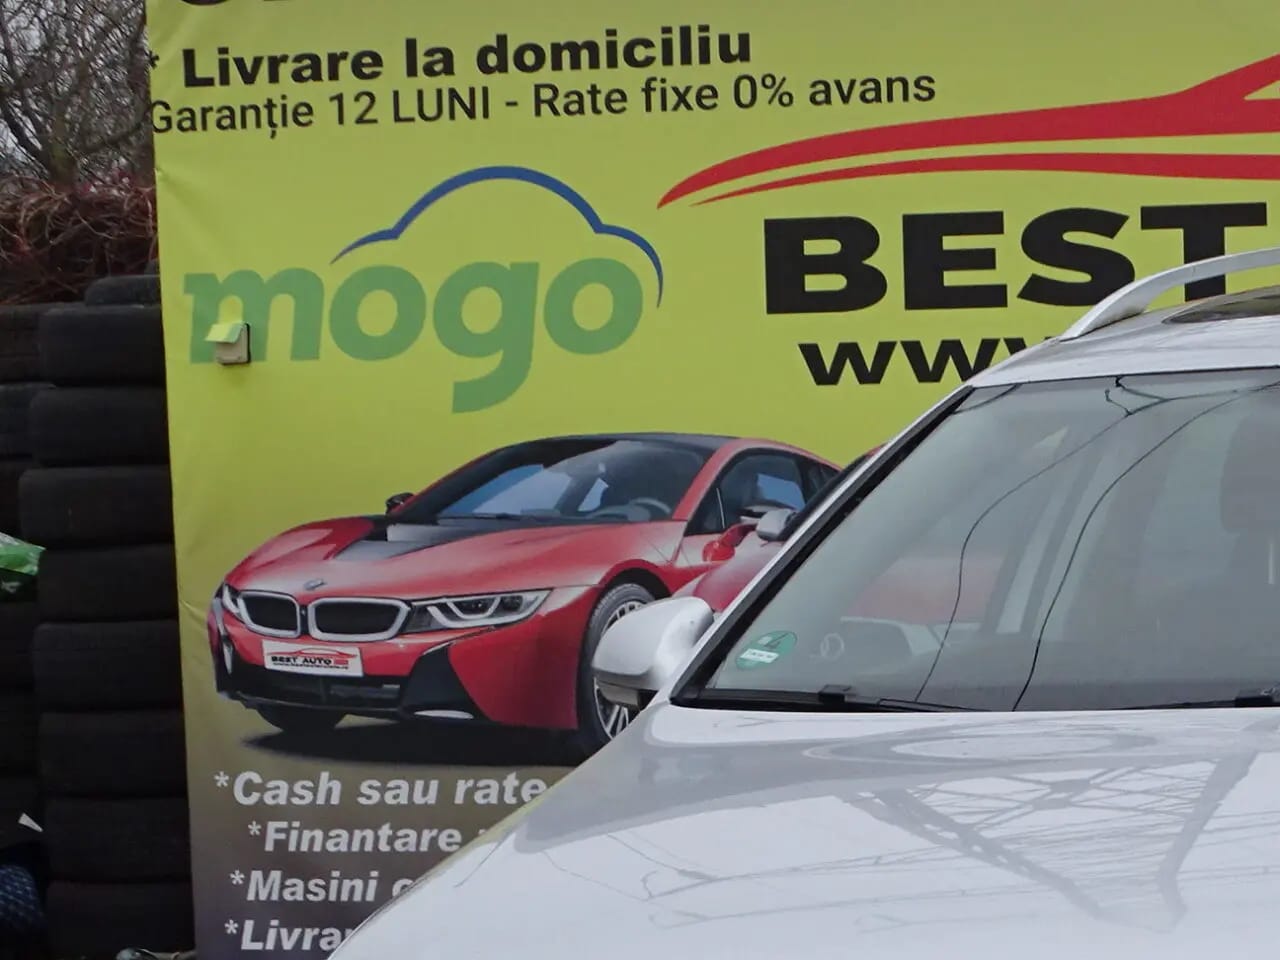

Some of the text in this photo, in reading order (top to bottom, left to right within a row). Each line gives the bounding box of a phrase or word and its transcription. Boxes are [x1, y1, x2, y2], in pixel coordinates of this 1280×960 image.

[182, 25, 751, 88] Livrare la domiciliu
[150, 95, 314, 139] Garanție
[329, 91, 379, 125] 12
[392, 86, 490, 123] LUNI
[534, 83, 628, 117] Rate
[642, 77, 719, 113] fixe
[733, 73, 794, 109] 0%
[809, 75, 936, 107] avans
[764, 202, 1268, 315] BEST
[183, 258, 644, 413] mogo
[798, 337, 1056, 386] ww
[357, 779, 438, 805] sau
[454, 772, 547, 804] rate
[225, 919, 352, 951] Livra
